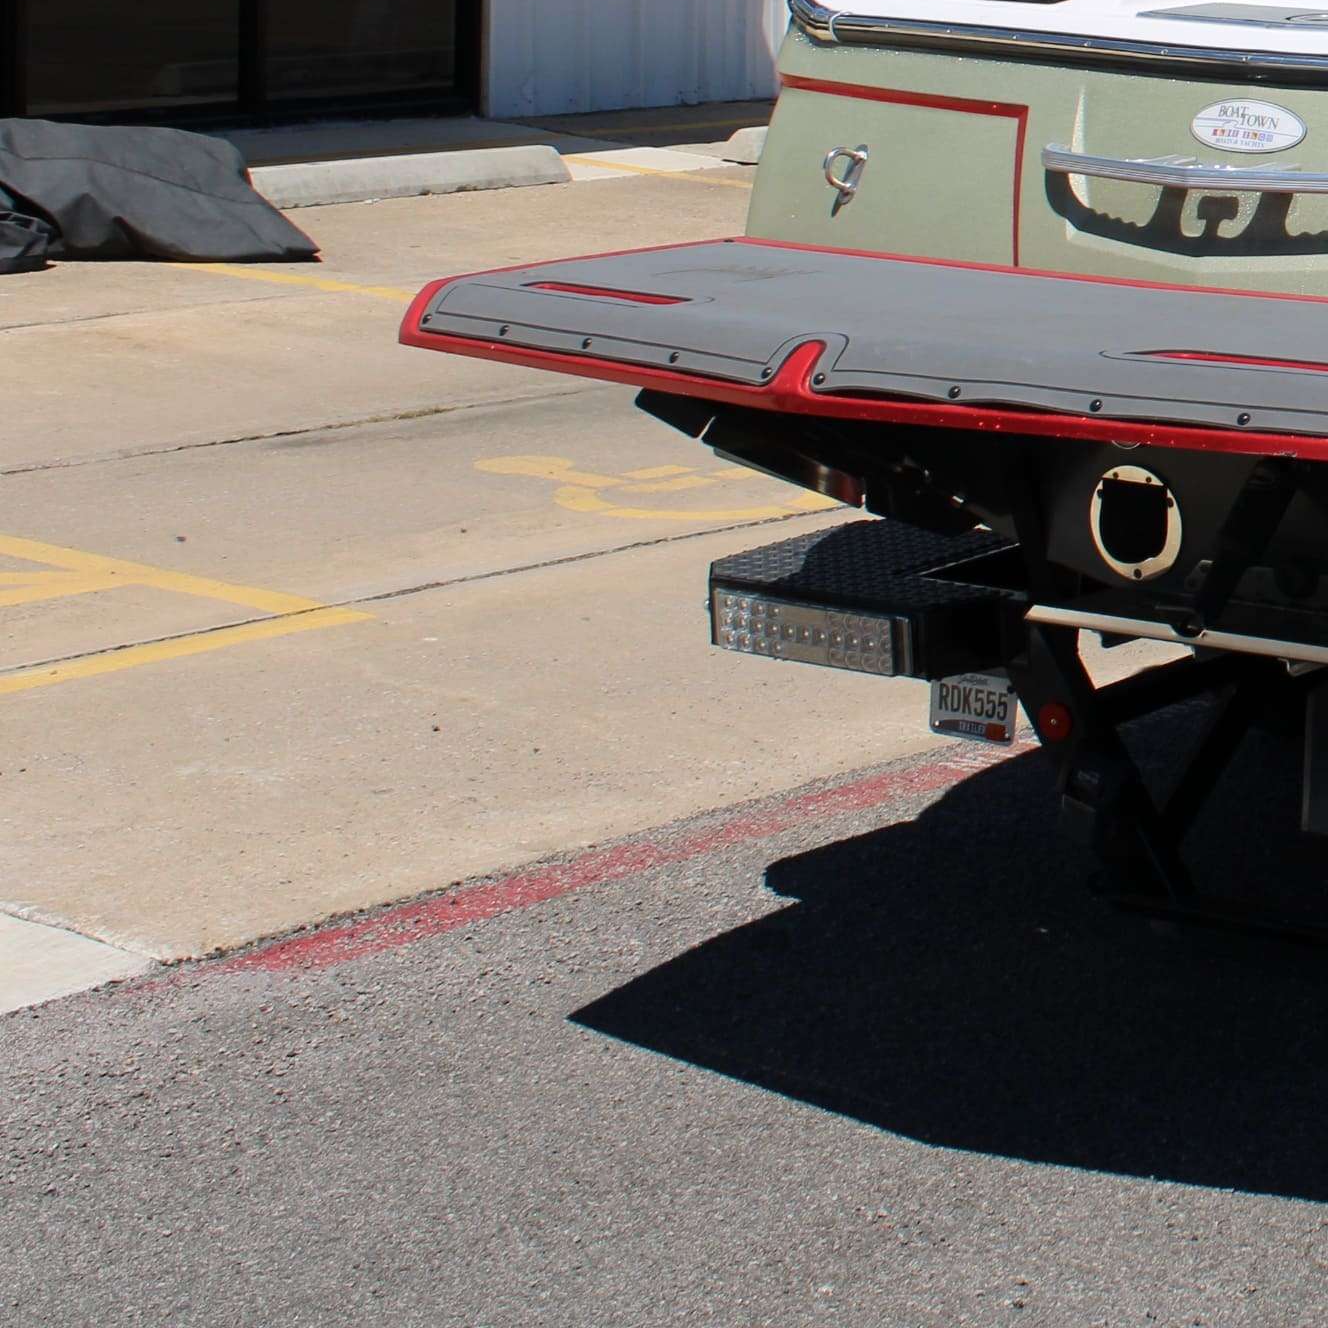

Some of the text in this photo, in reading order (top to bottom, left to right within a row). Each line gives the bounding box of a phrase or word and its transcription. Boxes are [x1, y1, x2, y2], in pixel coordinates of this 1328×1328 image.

[1218, 105, 1249, 118] BOAT
[1239, 113, 1278, 129] TOWN
[938, 683, 1008, 722] RDK555
